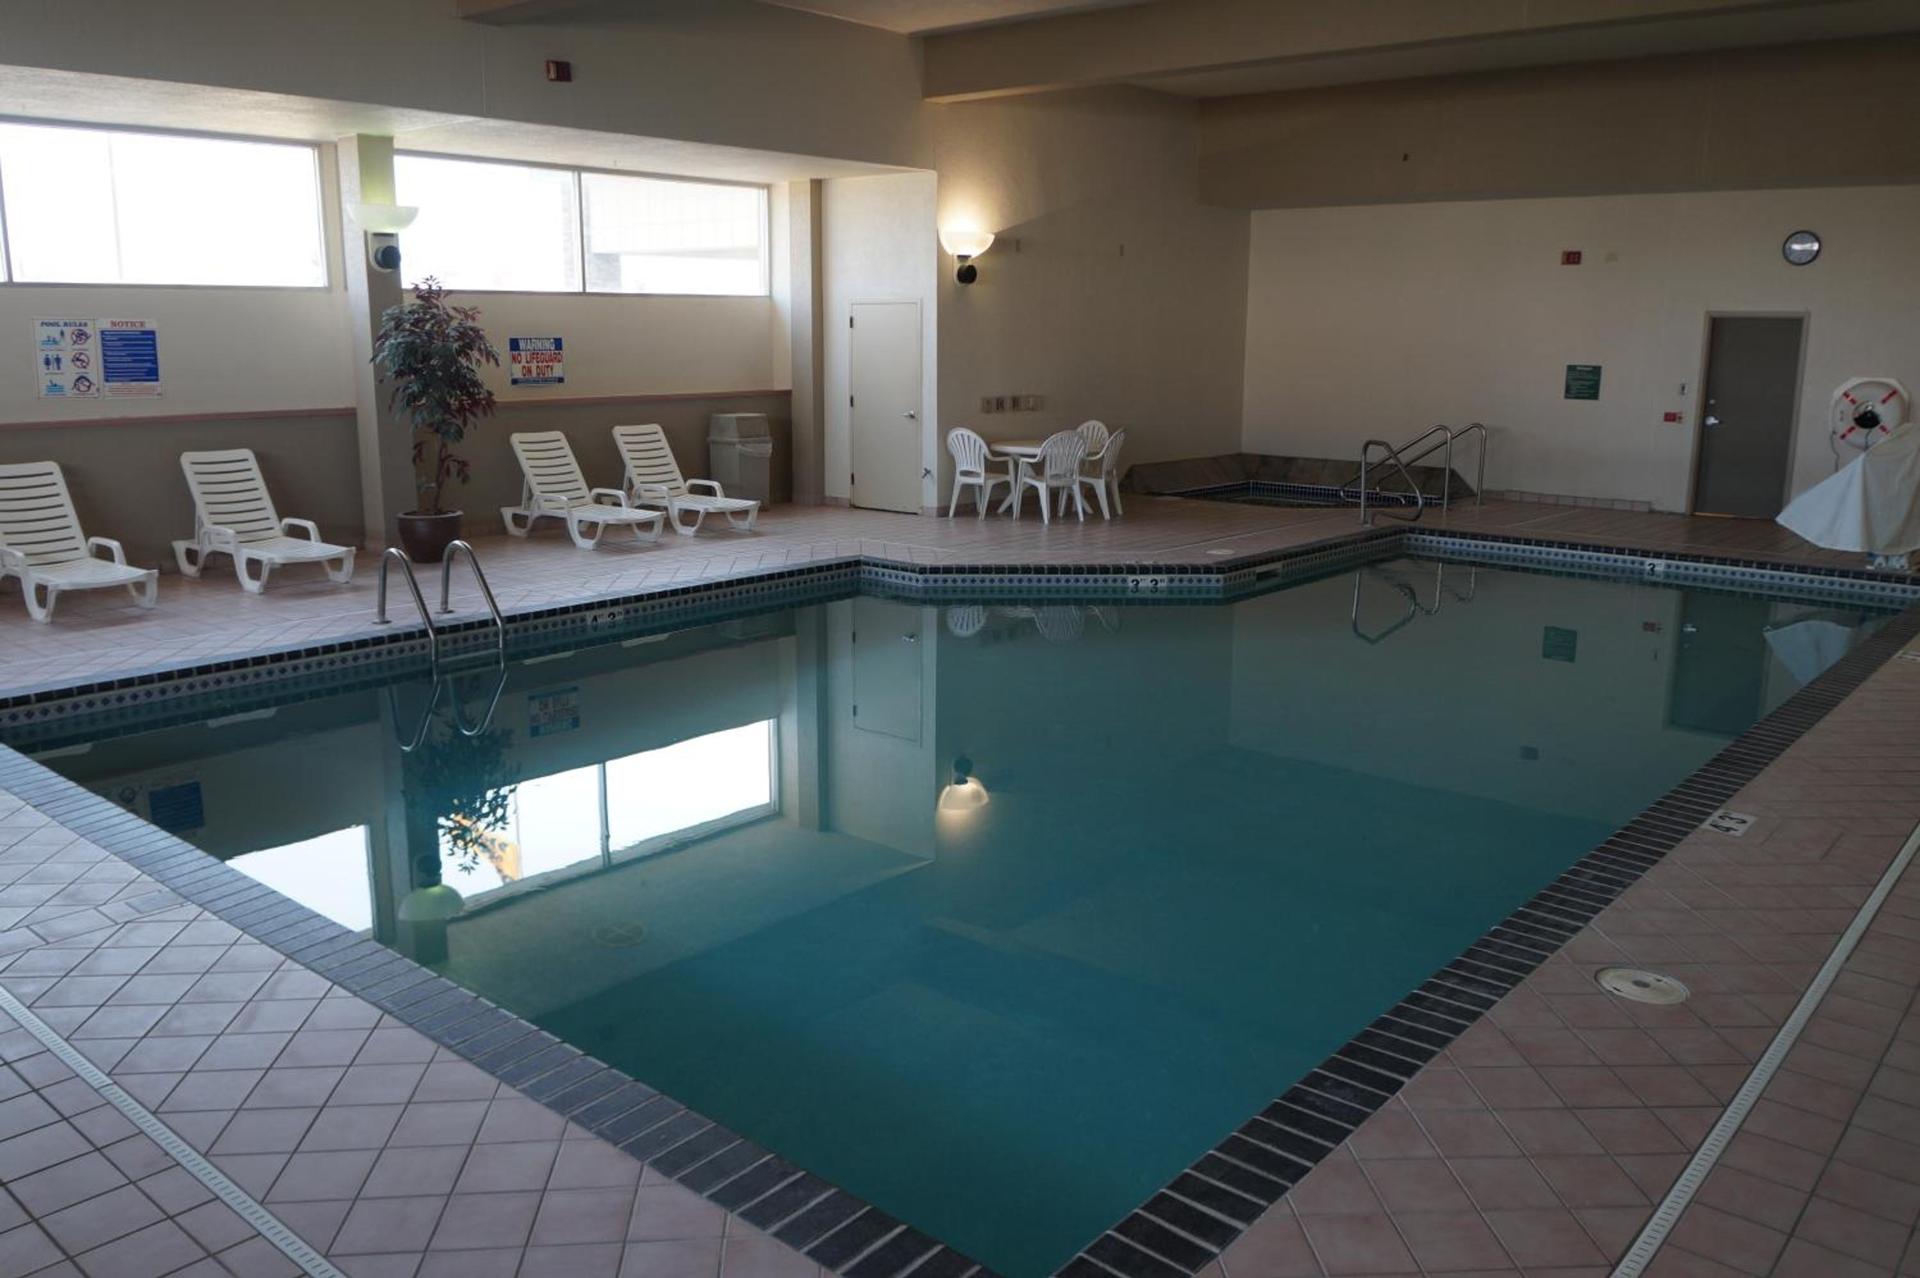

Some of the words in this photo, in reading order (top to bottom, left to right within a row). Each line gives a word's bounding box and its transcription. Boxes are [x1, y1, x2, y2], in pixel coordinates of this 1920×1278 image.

[110, 320, 146, 329] NOTICE
[519, 338, 556, 351] WARNING
[511, 352, 522, 364] NO
[526, 351, 563, 364] LIFEGUARD
[521, 364, 532, 377] ON
[536, 364, 554, 377] DUTY
